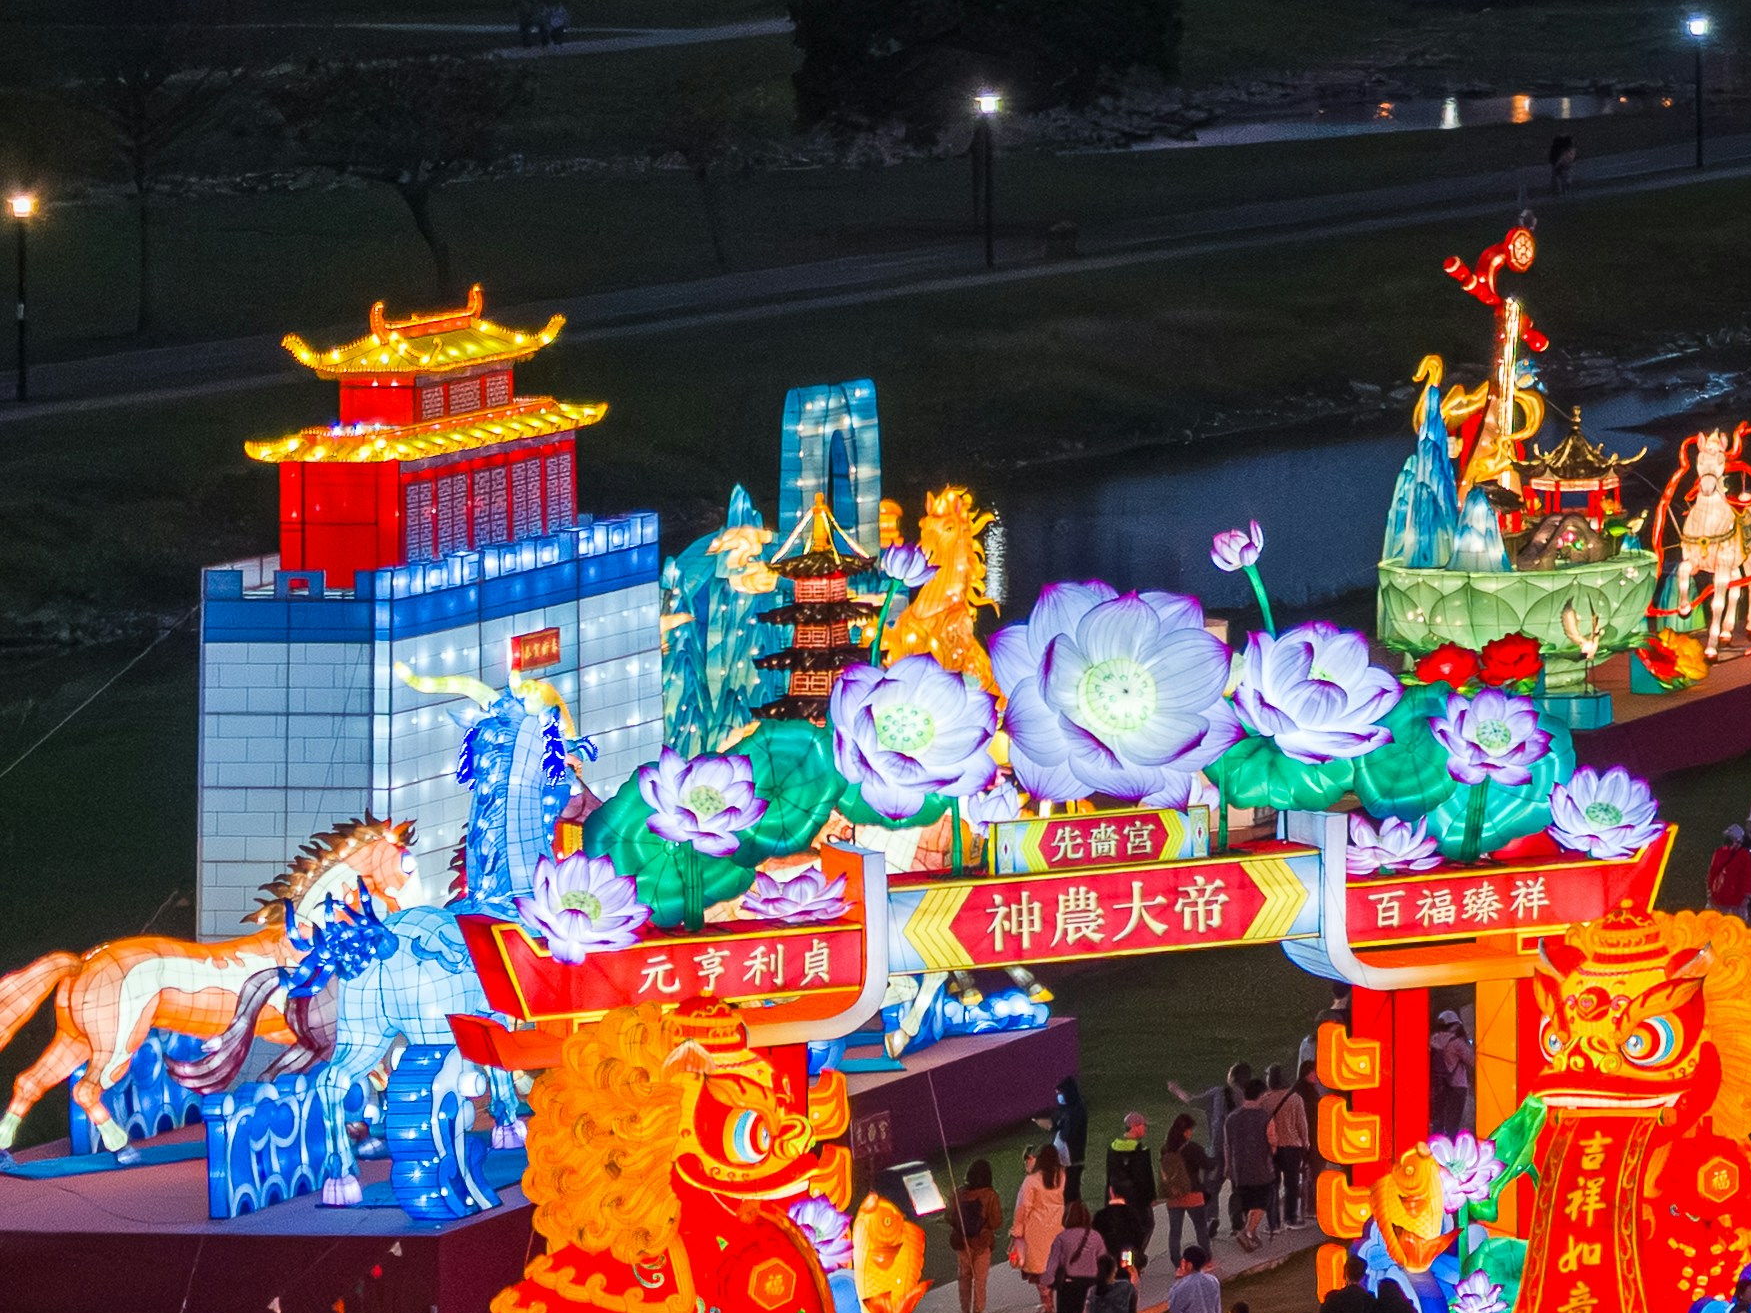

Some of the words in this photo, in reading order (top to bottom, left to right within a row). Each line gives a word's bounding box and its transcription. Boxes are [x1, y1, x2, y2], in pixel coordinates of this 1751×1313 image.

[1051, 820, 1156, 862] 先嗇宮
[985, 875, 1231, 952] 神農大帝
[1368, 876, 1550, 928] 百福臻祥
[638, 939, 830, 994] 元亨利貞
[1712, 1169, 1730, 1190] 福
